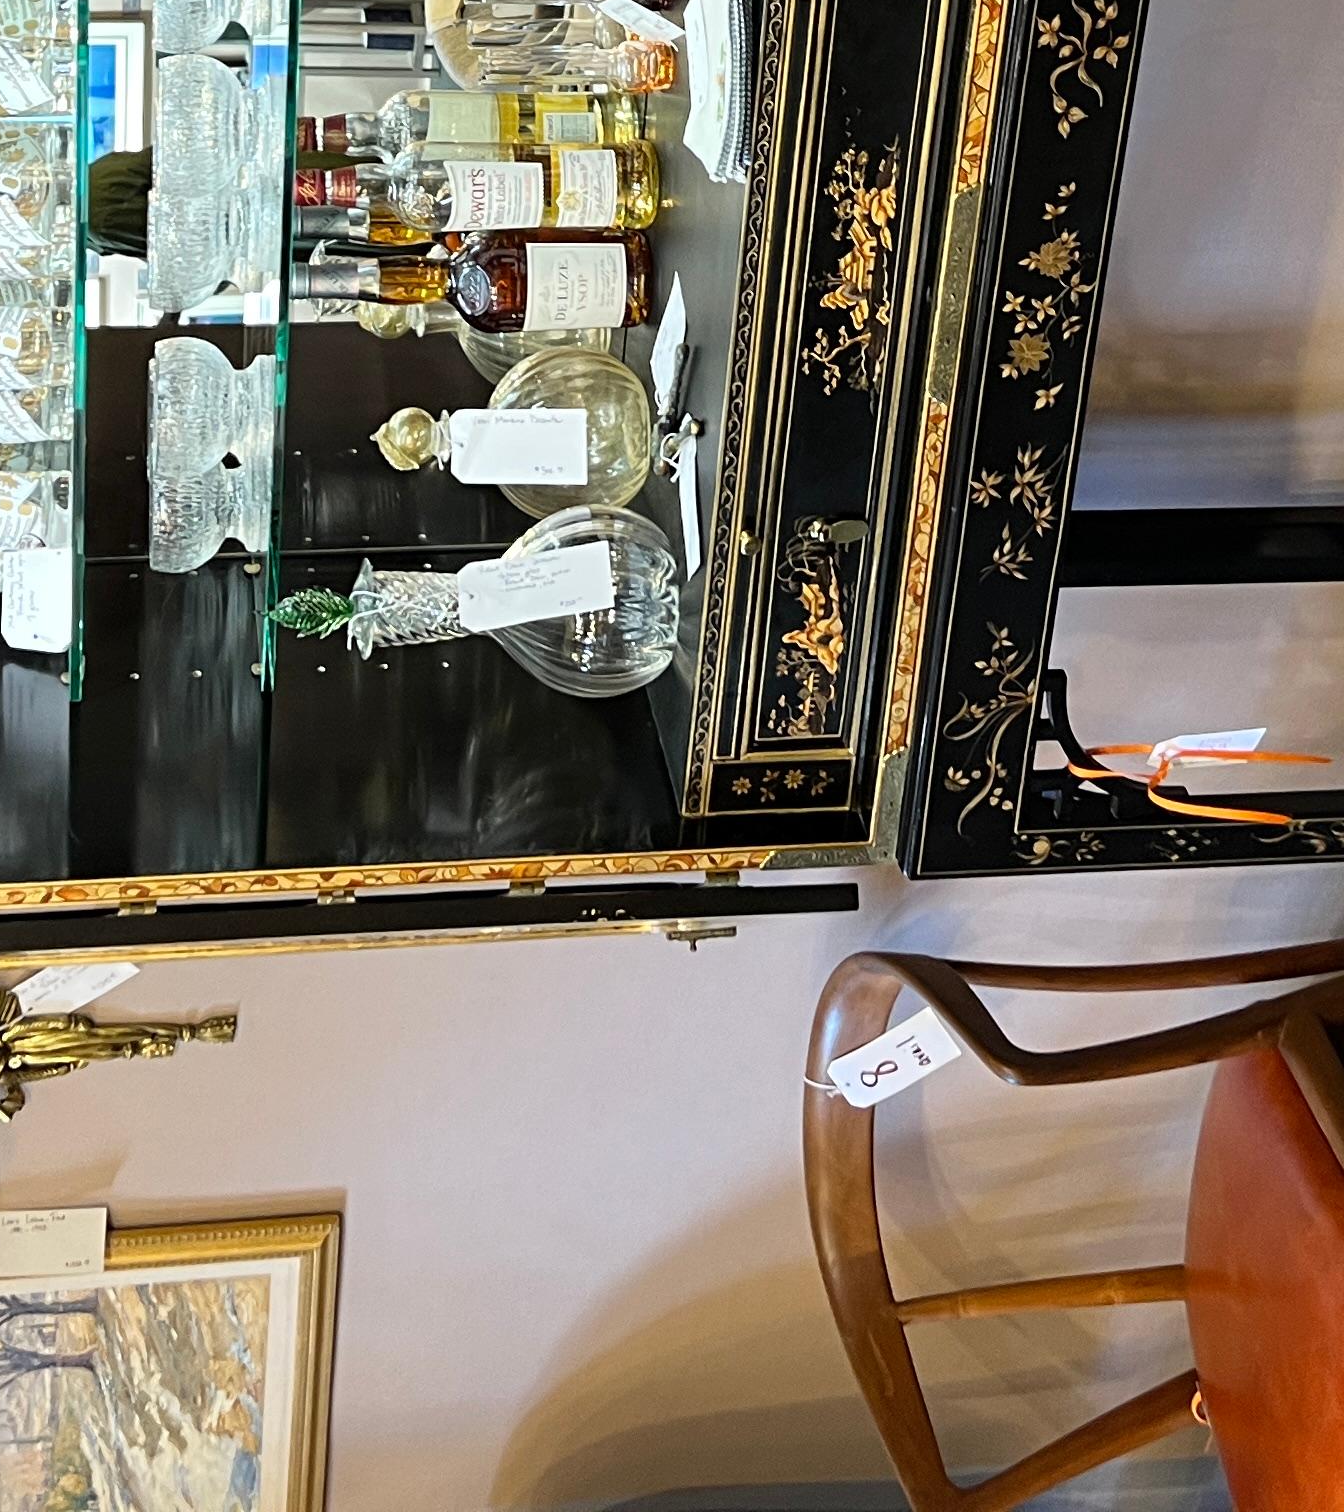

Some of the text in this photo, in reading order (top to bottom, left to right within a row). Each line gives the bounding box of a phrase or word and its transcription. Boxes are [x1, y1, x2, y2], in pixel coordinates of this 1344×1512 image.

[464, 168, 486, 229] Dewar's
[554, 260, 569, 321] DE LUZE
[575, 274, 588, 312] VSOP
[895, 1035, 932, 1067] avail
[860, 1060, 898, 1088] 8
